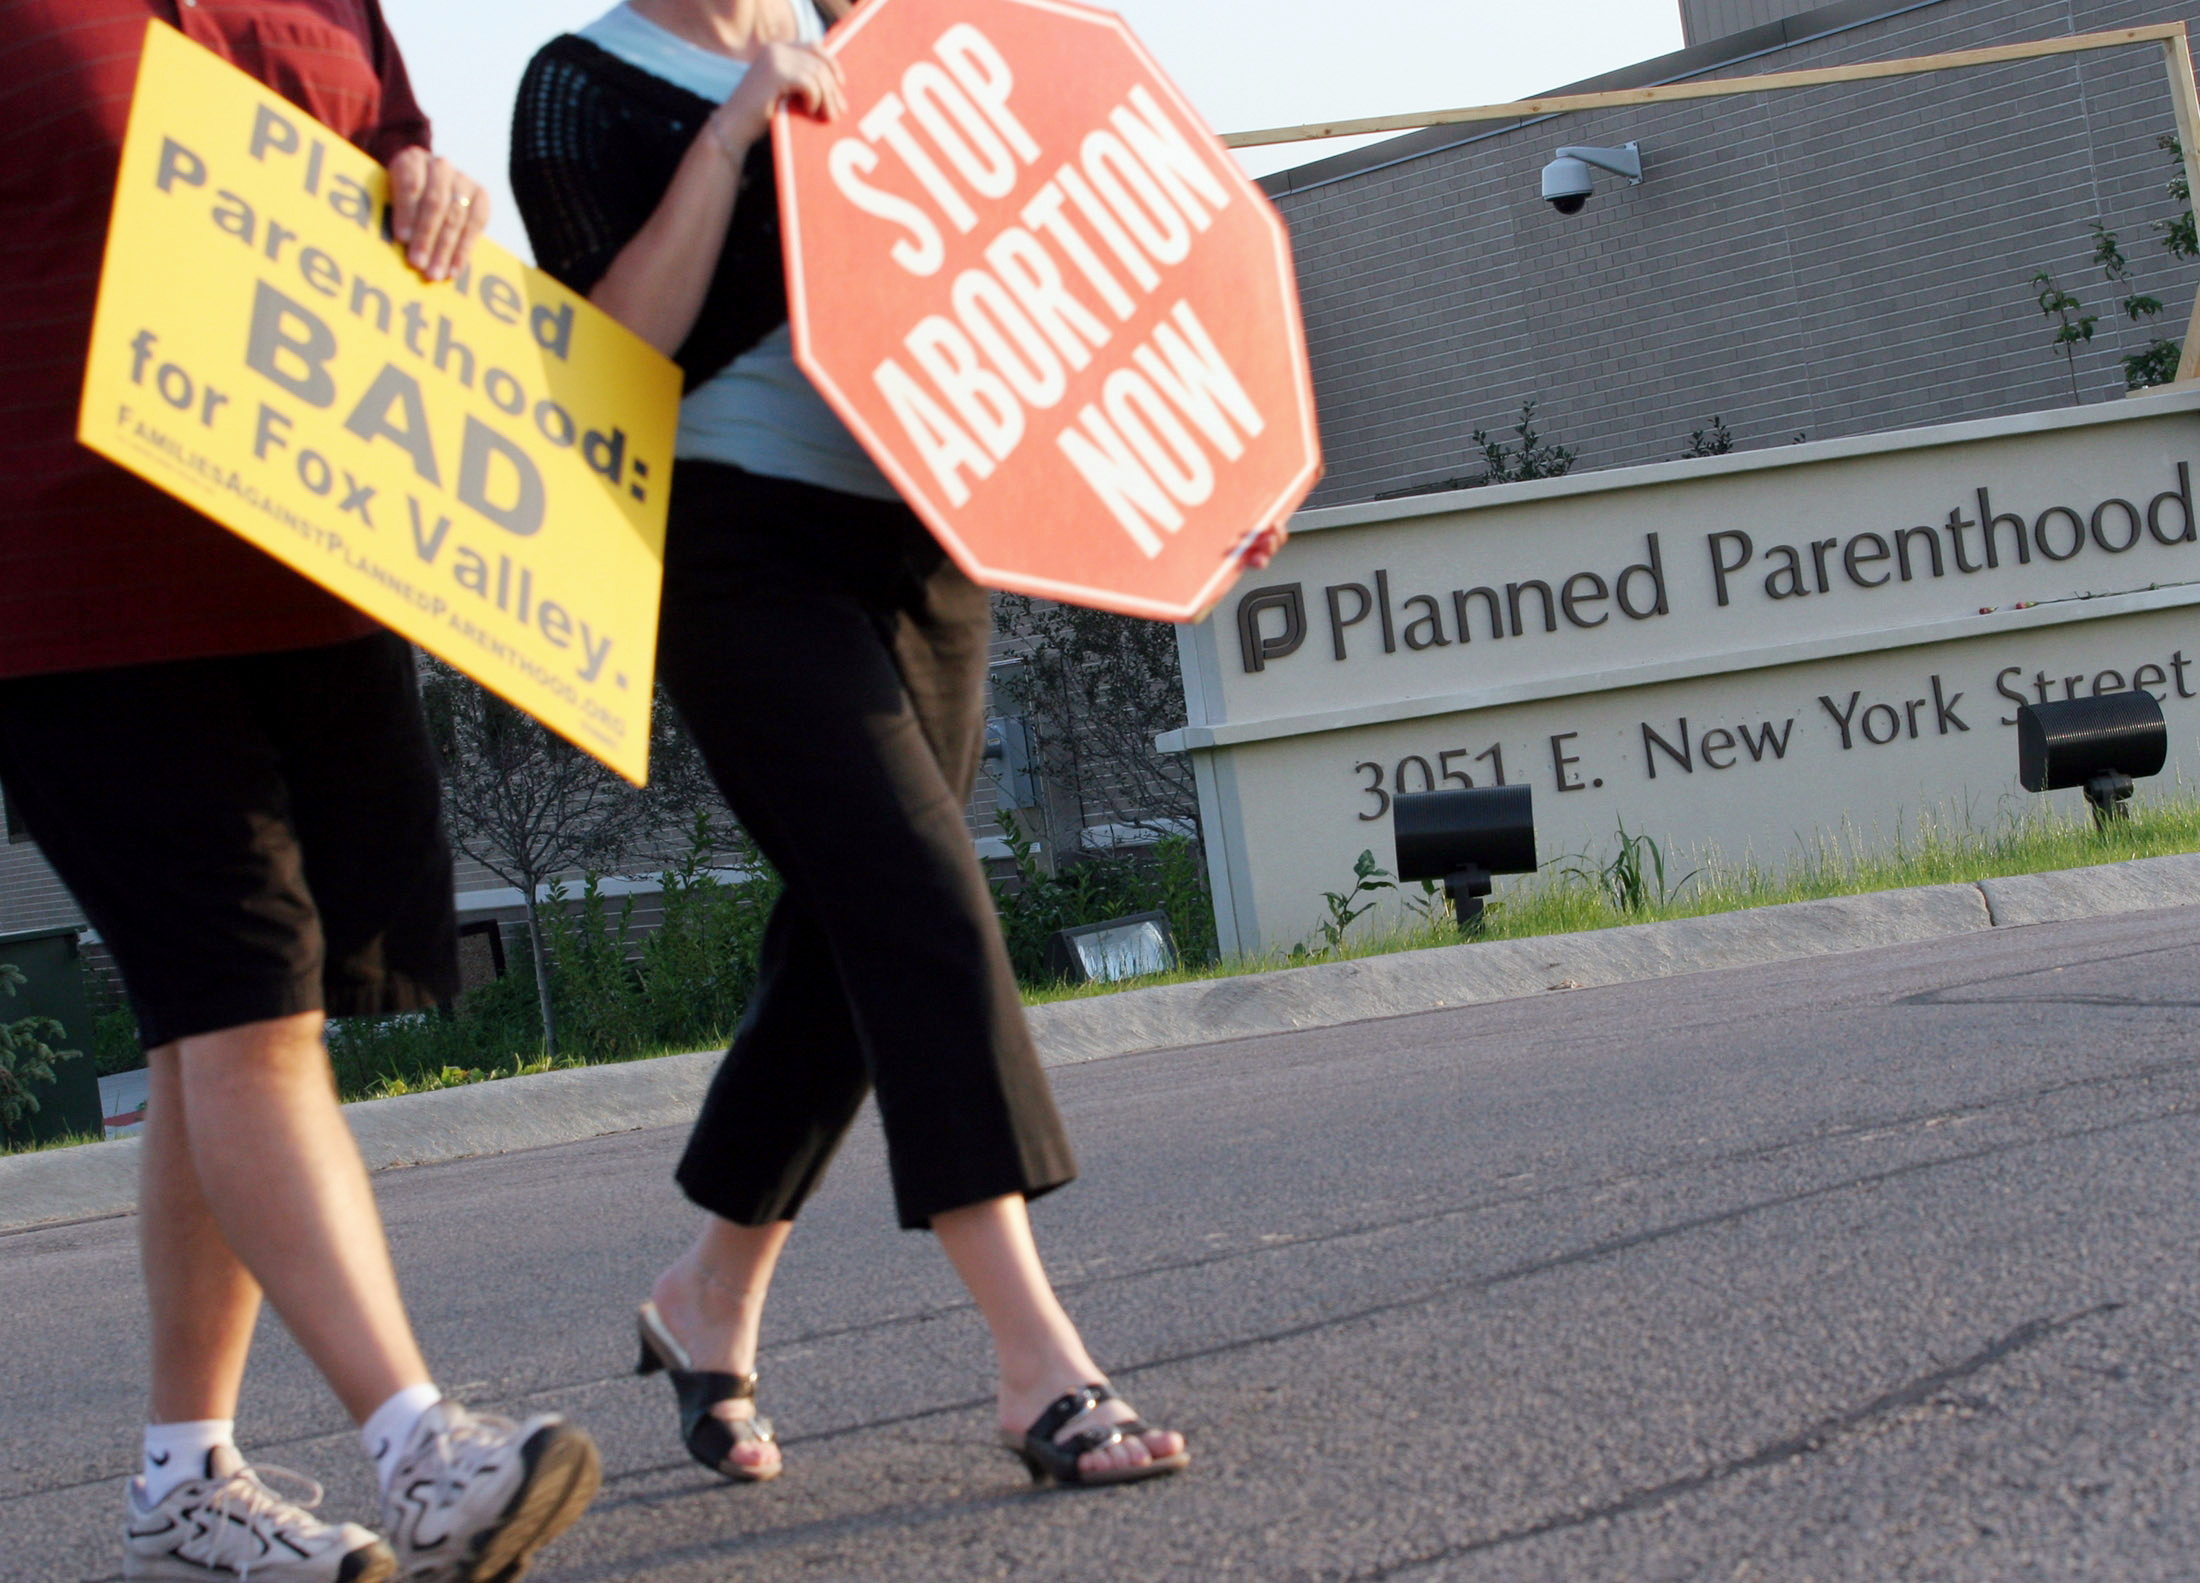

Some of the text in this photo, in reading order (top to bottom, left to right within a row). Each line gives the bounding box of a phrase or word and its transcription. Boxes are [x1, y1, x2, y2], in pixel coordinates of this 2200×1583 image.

[248, 102, 574, 361] Plaed
[827, 22, 1041, 276] STOP
[154, 135, 650, 503] Parenthood:
[244, 277, 547, 538] BAD
[871, 84, 1231, 510] ABORTION
[129, 329, 229, 429] for
[253, 402, 378, 530] Fox
[407, 494, 630, 690] Valley.
[1055, 298, 1266, 560] NOW
[1325, 532, 1670, 661] Planned
[1707, 461, 2197, 606] Parenthood
[1354, 650, 2197, 822] 3051 E. New York Street
